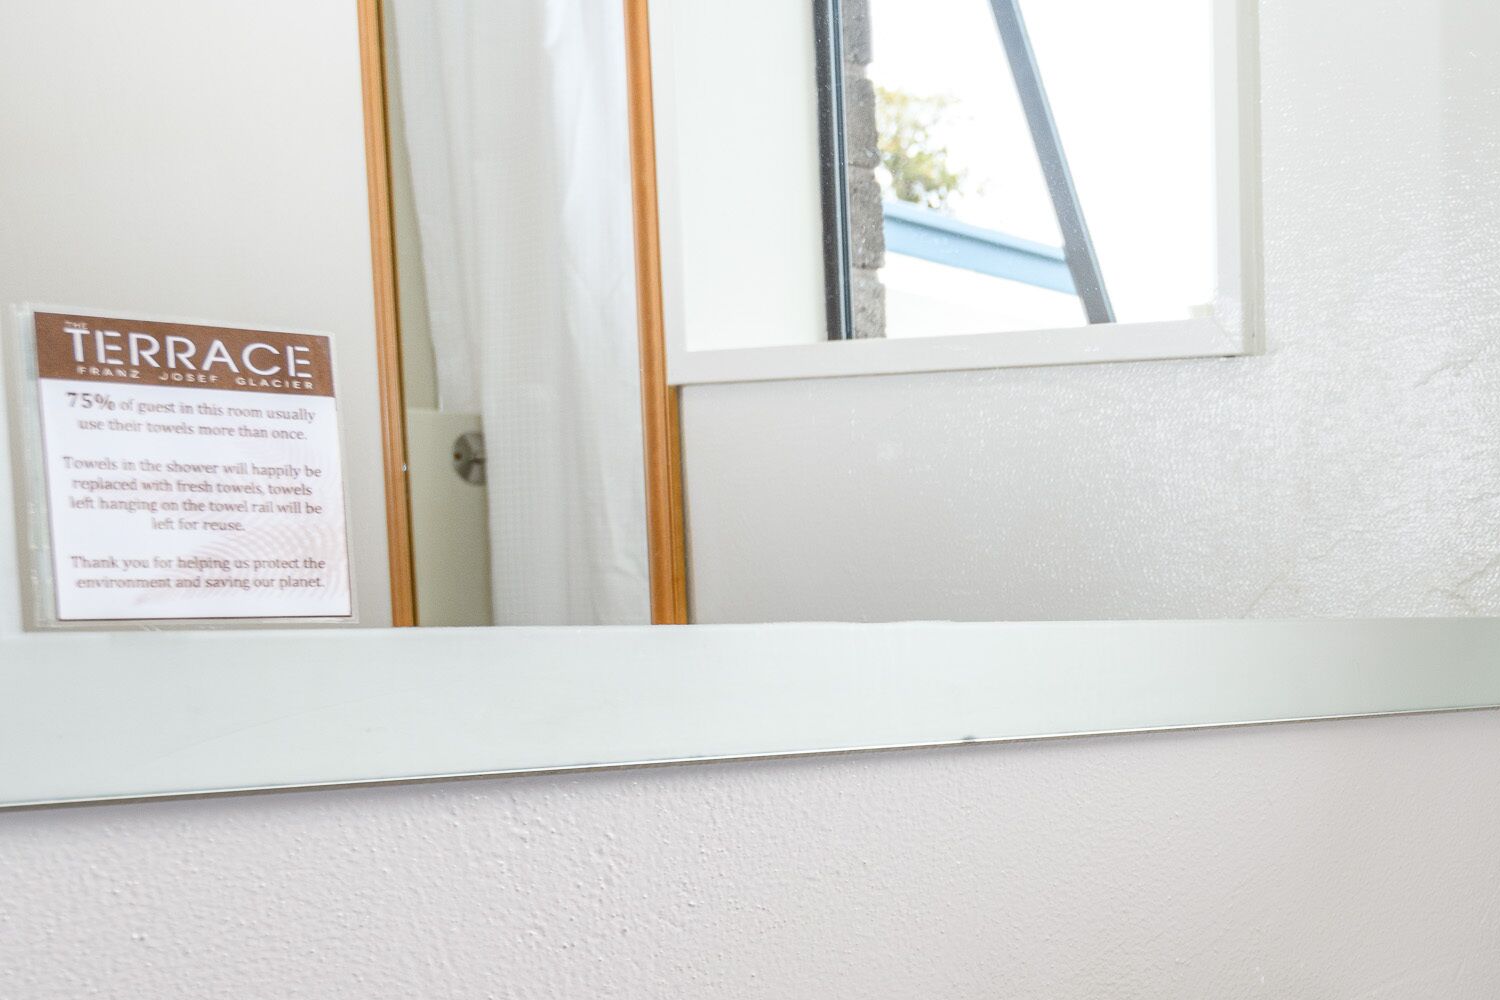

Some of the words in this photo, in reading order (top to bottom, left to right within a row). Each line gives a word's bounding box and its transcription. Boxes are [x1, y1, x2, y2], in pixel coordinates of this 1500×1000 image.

[63, 327, 313, 378] TERRACE
[77, 365, 141, 379] FRANZ
[158, 372, 220, 383] JOSEF
[235, 377, 314, 390] GLACIER
[65, 391, 116, 411] 75%
[119, 399, 135, 412] of
[137, 402, 176, 415] guest
[179, 402, 194, 414] in
[197, 402, 225, 417] this
[227, 407, 263, 418] room
[266, 408, 316, 425] usually
[79, 420, 104, 430] use
[107, 419, 142, 433] their
[146, 422, 195, 435] towels
[198, 425, 236, 437] more
[238, 425, 268, 438] than
[271, 430, 308, 441] once.
[62, 456, 118, 471] Towels
[122, 460, 137, 471] in
[140, 459, 162, 472] the
[166, 460, 218, 475] shower
[222, 463, 249, 475] will
[251, 463, 301, 479] happily
[304, 465, 322, 478] be
[72, 477, 138, 492] replaced
[141, 479, 173, 492] with
[176, 479, 214, 493] fresh
[267, 484, 313, 496] towels
[69, 496, 95, 509] left
[98, 497, 158, 513] hanging
[161, 501, 179, 511] on
[182, 499, 206, 512] the
[209, 500, 249, 513] towel
[251, 501, 274, 514] rail
[276, 501, 302, 514] will
[305, 502, 323, 515] be
[150, 518, 175, 530] left
[177, 518, 200, 530] for
[203, 521, 246, 531] reuse.
[70, 556, 119, 569] Thank
[122, 559, 150, 572] you
[153, 556, 173, 569] for
[176, 556, 232, 572] helping
[234, 559, 250, 569] us
[252, 558, 300, 572] protect
[302, 557, 327, 569] the
[76, 577, 173, 589] environment
[175, 576, 201, 588] and
[205, 576, 251, 591] saving
[253, 579, 276, 588] our
[279, 576, 327, 590] planet.
